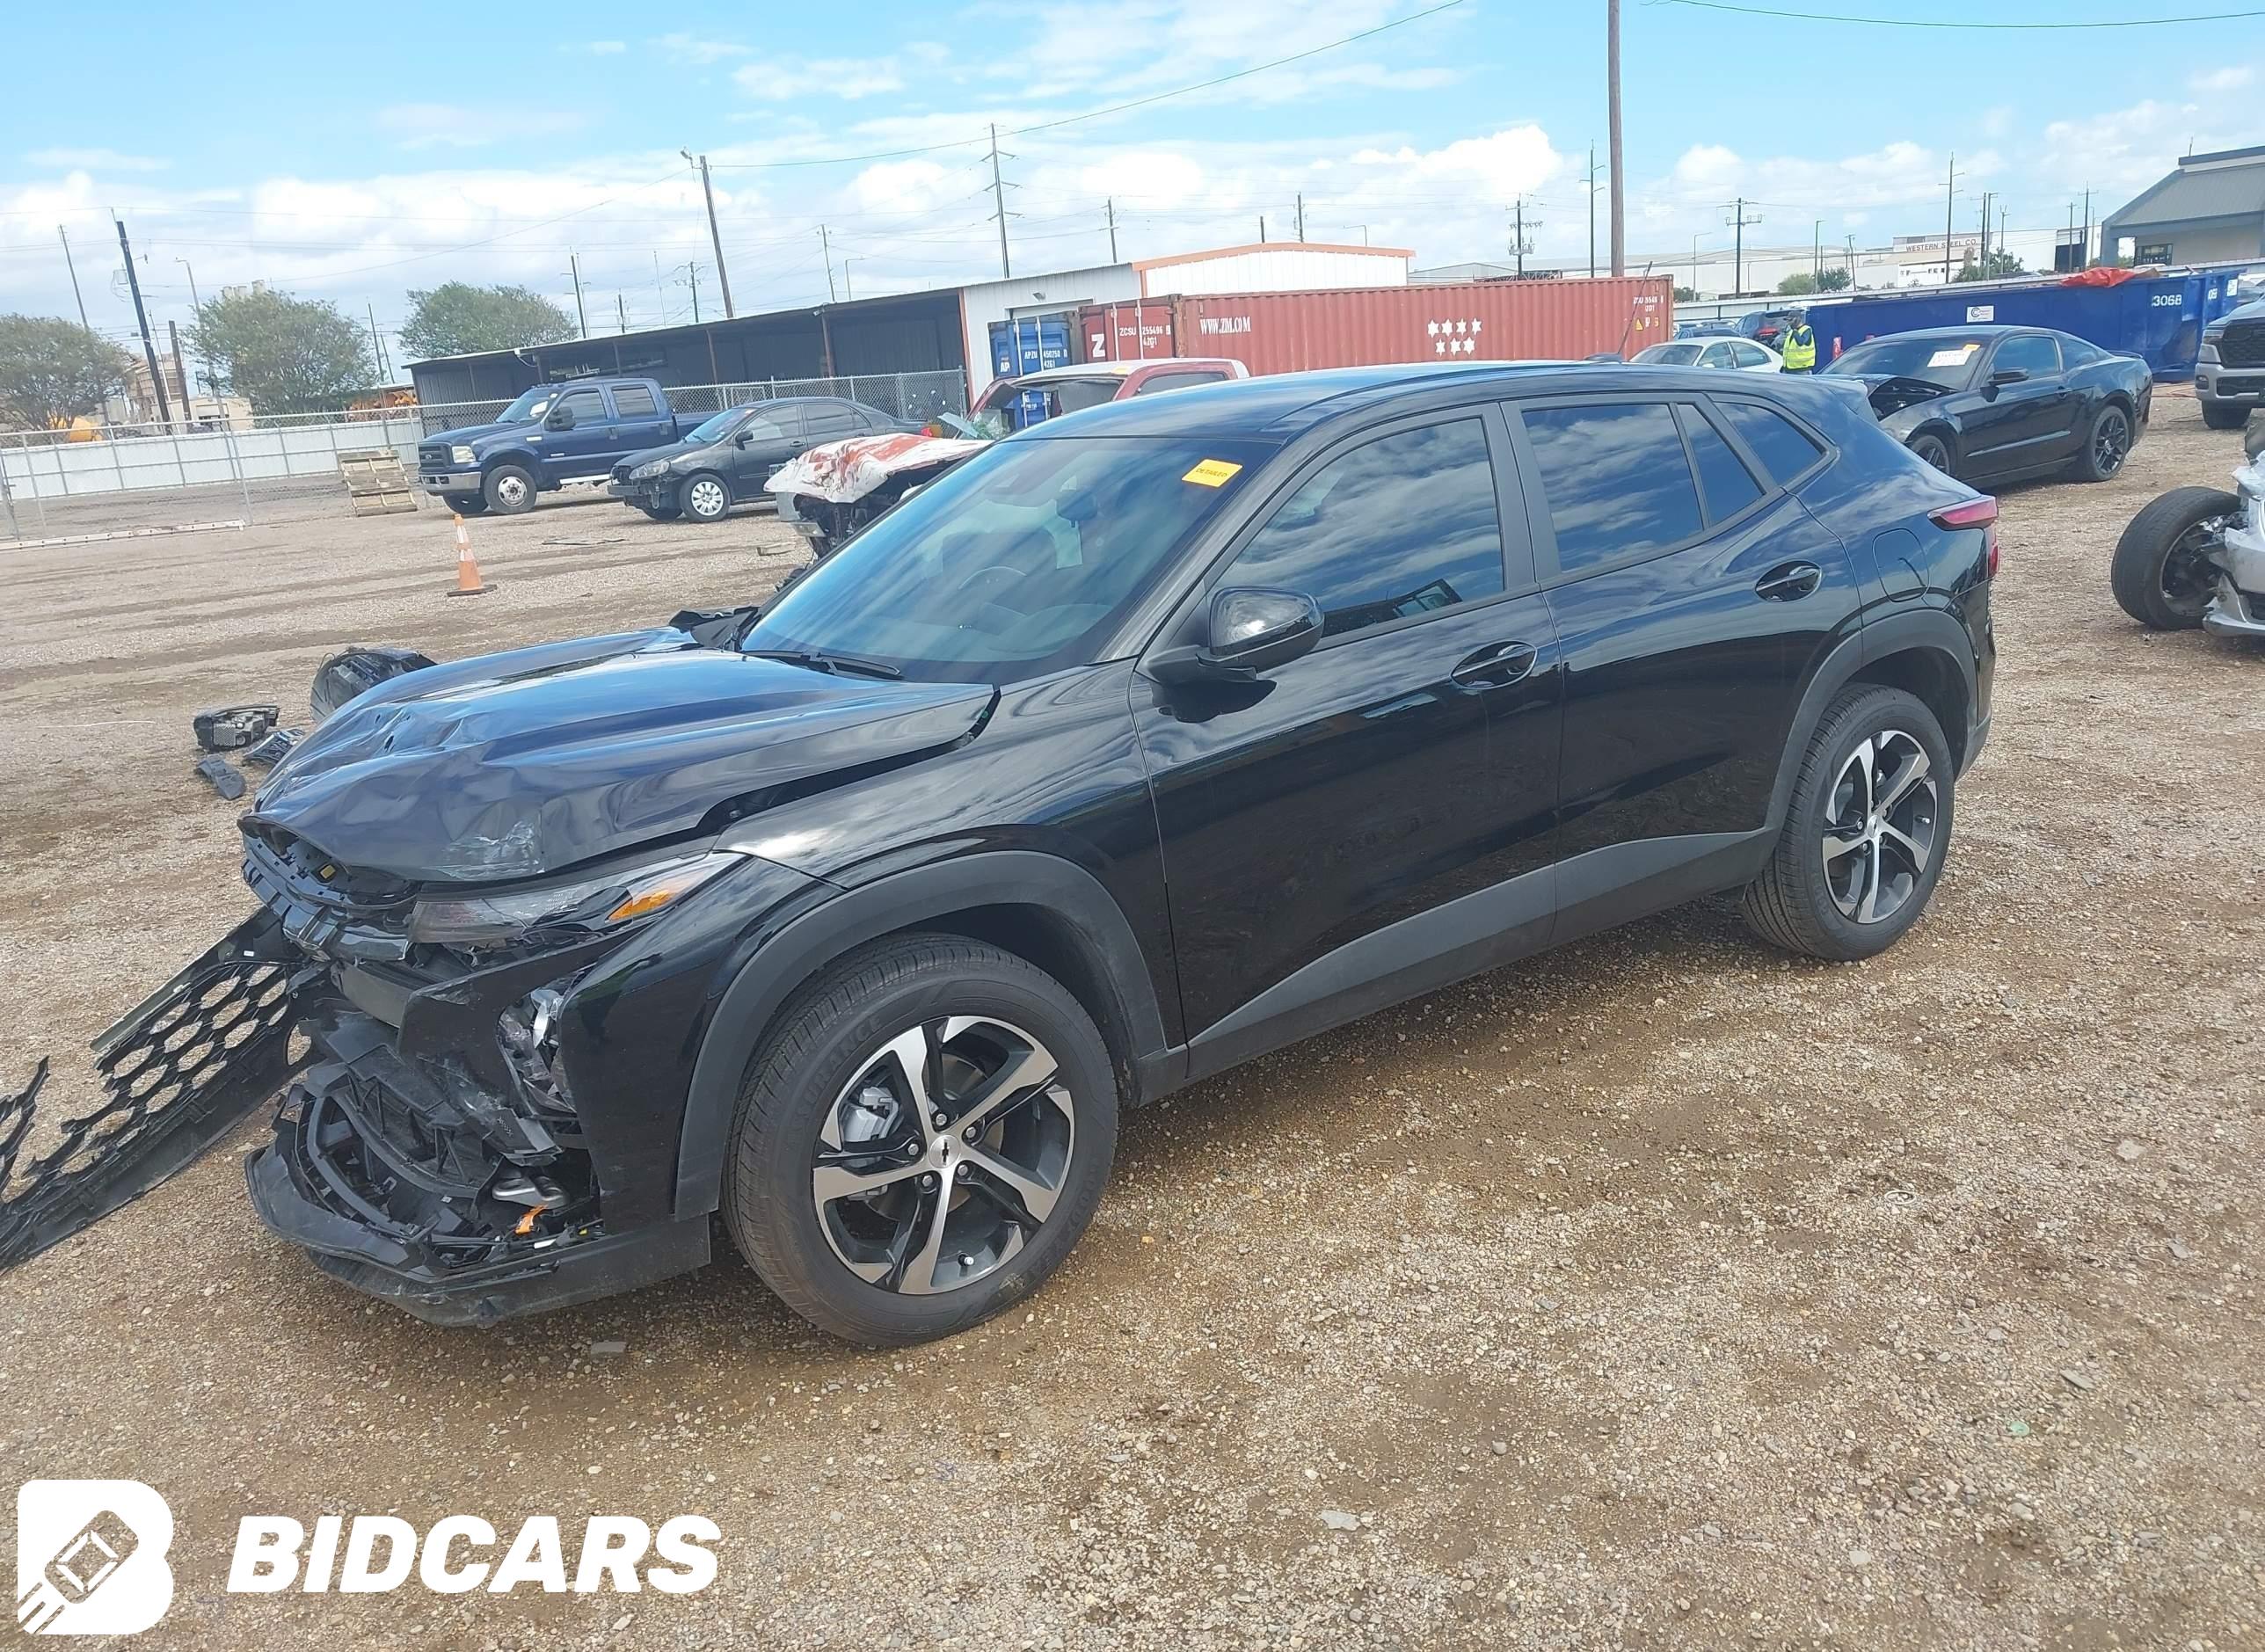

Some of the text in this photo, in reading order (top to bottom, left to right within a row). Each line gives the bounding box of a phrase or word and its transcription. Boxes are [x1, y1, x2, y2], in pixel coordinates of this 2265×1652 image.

[1906, 243, 1939, 252] WESTERN
[1941, 240, 1963, 249] SEEL
[2152, 295, 2182, 307] 3068
[1119, 326, 1137, 337] ZCSU
[1091, 333, 1106, 358] Z
